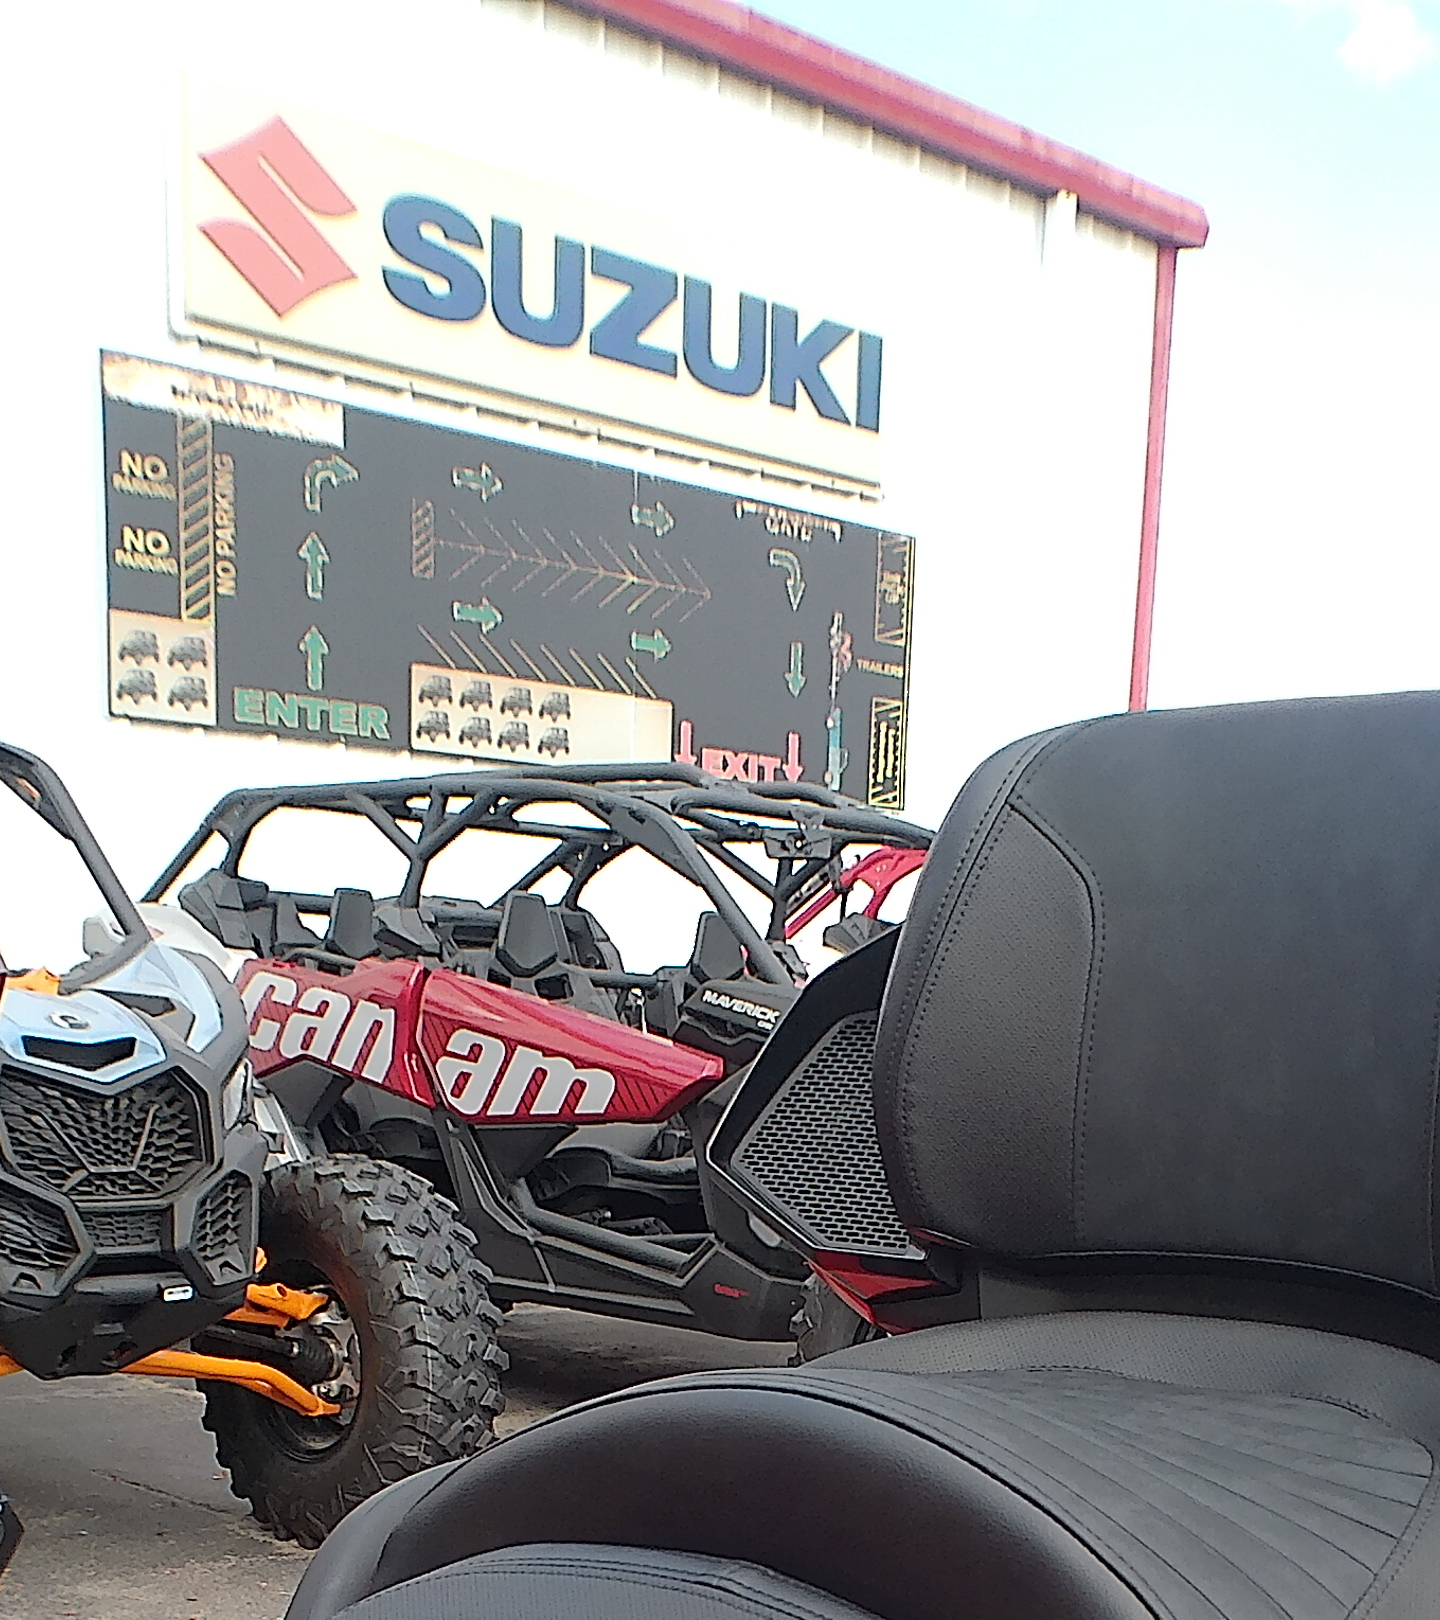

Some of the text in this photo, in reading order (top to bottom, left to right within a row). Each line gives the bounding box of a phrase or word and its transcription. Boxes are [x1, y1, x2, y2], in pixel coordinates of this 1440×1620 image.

[380, 190, 884, 435] SUZUKI
[119, 449, 169, 483] NO
[121, 524, 172, 557] NO
[213, 451, 238, 599] NO PARKING
[233, 685, 390, 741] ENTER
[701, 747, 782, 783] EXIT
[701, 989, 781, 1024] MAVERICK
[241, 970, 616, 1117] can am
